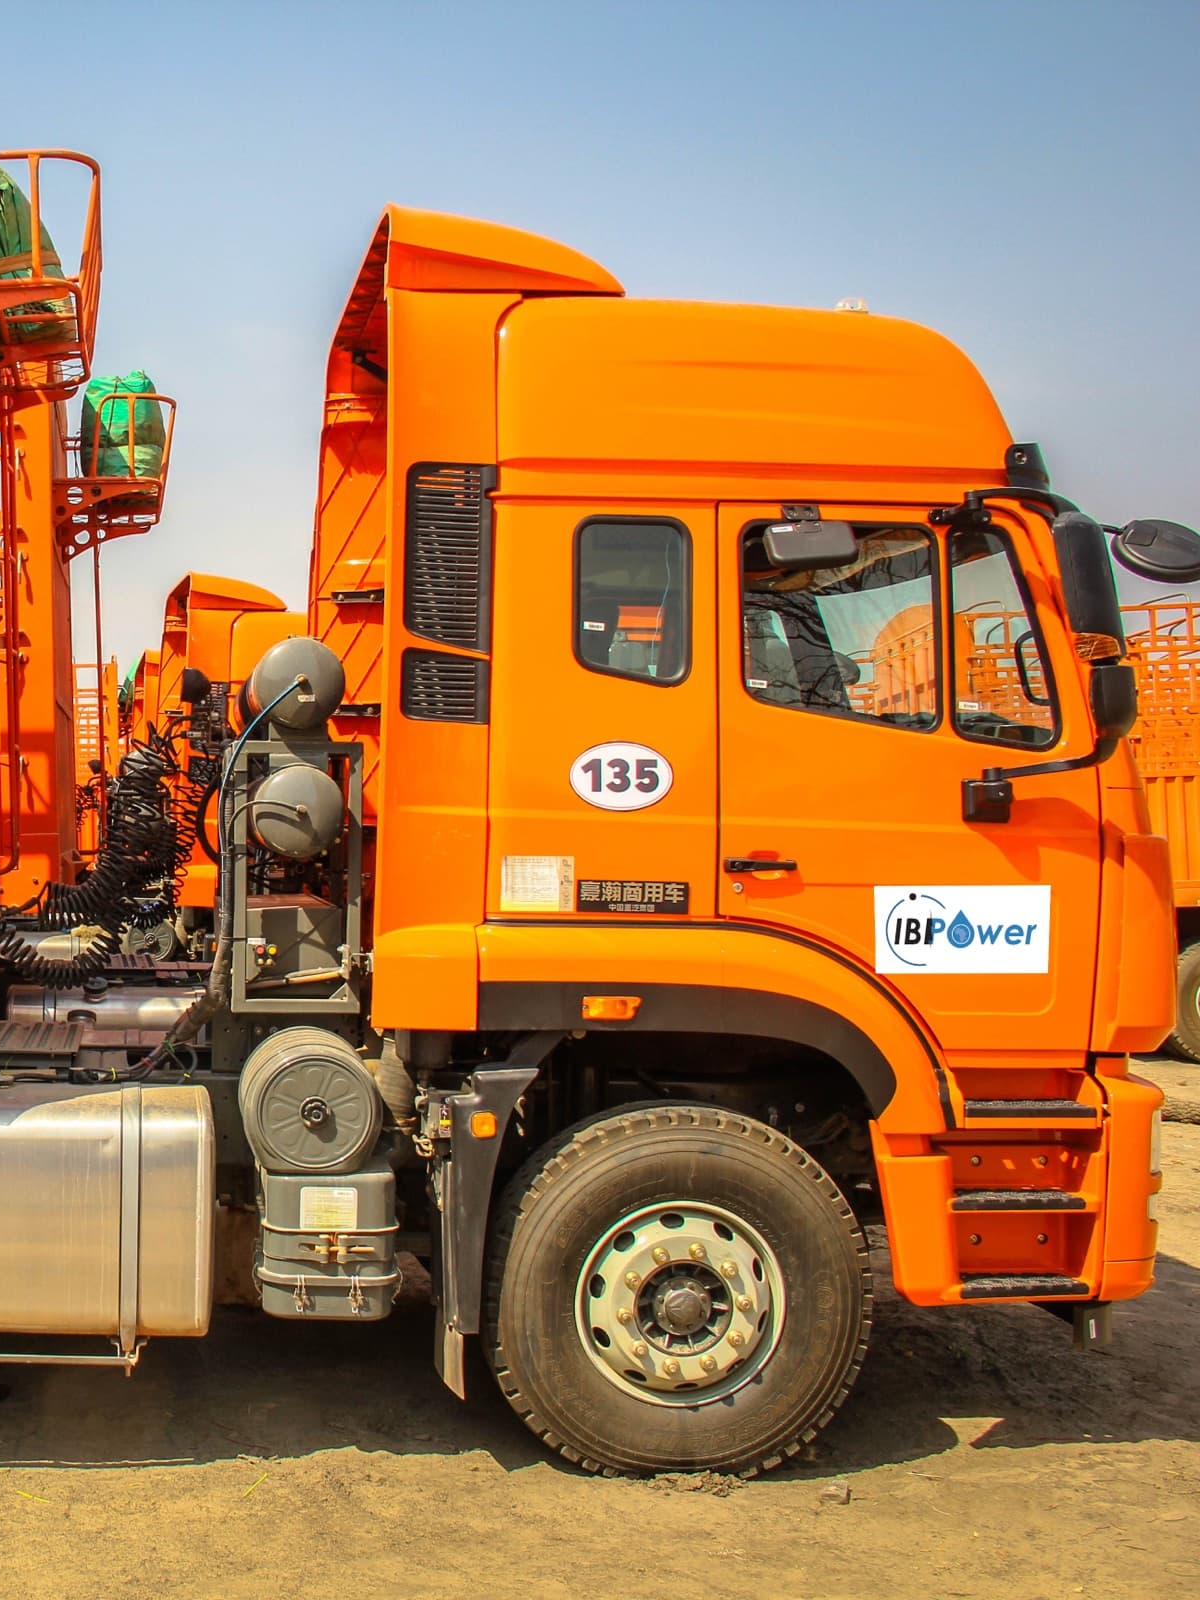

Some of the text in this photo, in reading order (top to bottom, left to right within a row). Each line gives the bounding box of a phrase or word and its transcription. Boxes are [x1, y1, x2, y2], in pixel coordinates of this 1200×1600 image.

[581, 758, 660, 793] 135
[580, 881, 685, 904] 豪瀚商用车
